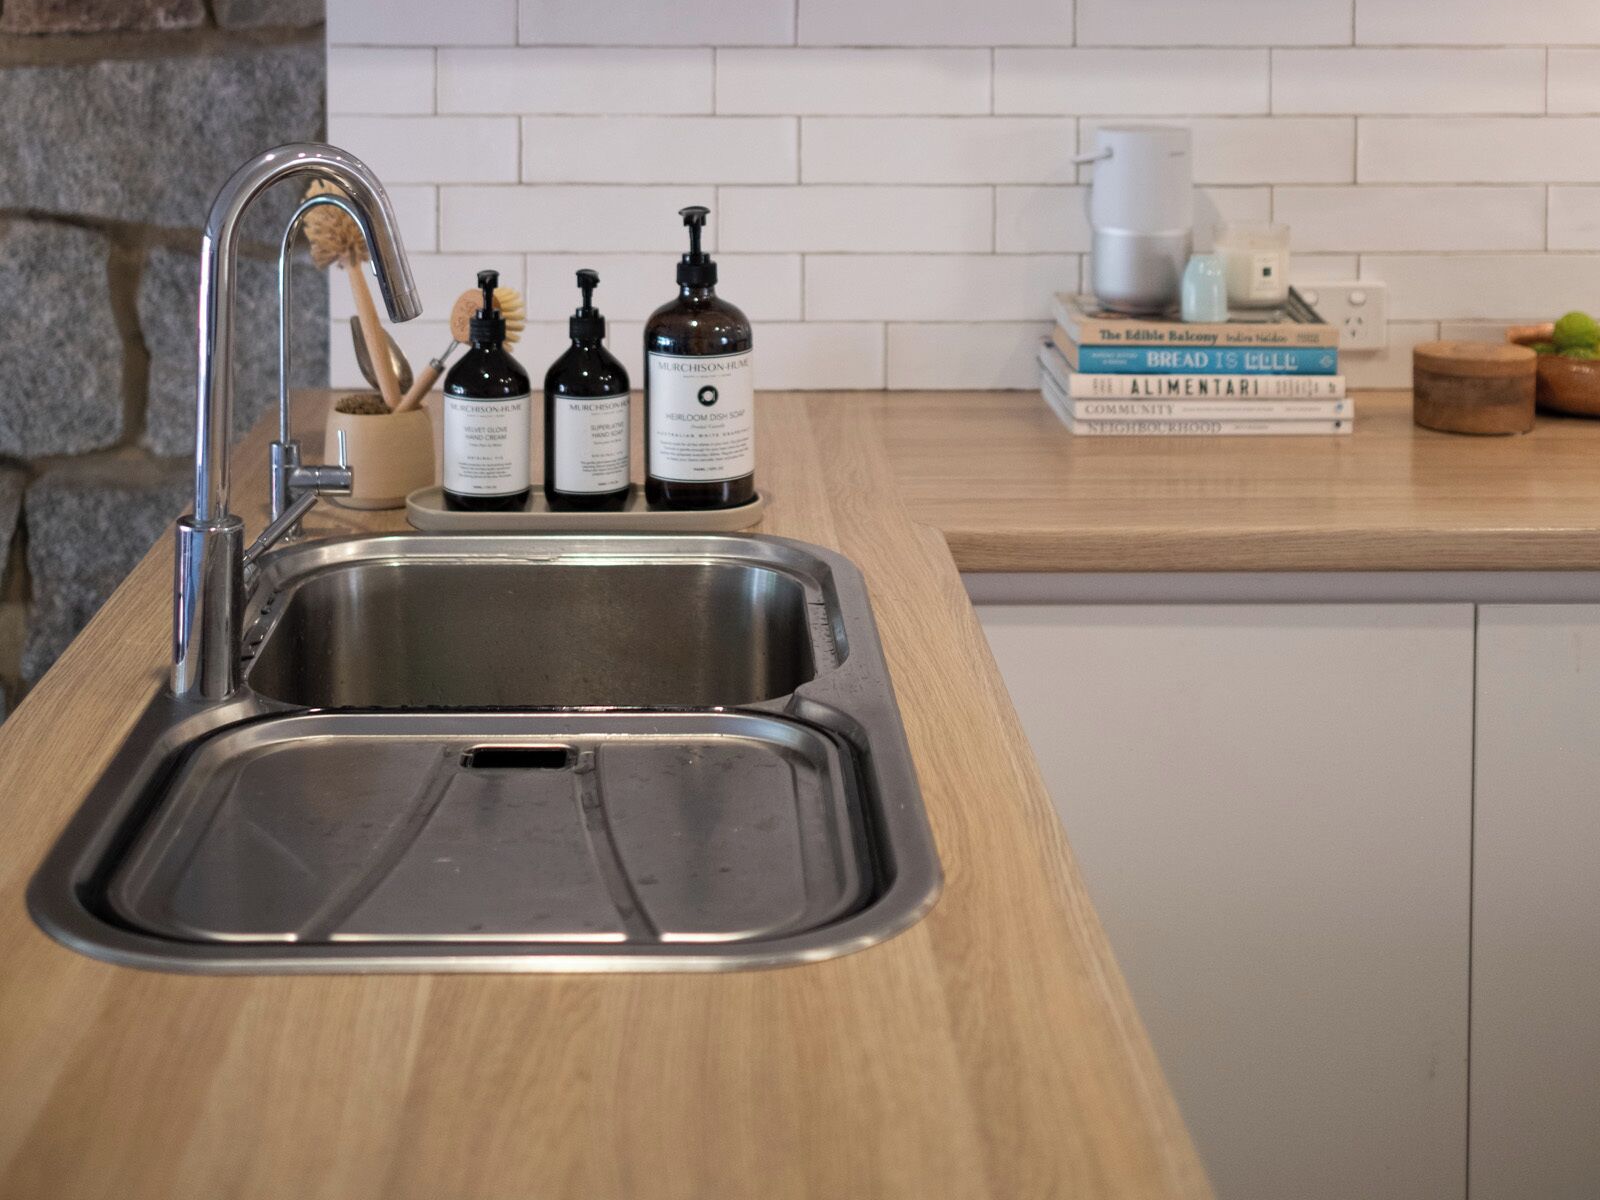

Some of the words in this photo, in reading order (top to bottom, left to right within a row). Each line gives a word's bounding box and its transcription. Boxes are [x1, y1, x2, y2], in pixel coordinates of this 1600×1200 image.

[1100, 329, 1121, 340] The
[1125, 329, 1165, 341] Edible
[1168, 329, 1218, 346] Balcony
[657, 359, 749, 373] MURCHISON-HUME
[1145, 350, 1210, 368] BREAD
[1215, 351, 1239, 369] IS
[1130, 378, 1260, 396] ALIMENTARI
[1084, 403, 1176, 415] COMMUNITY
